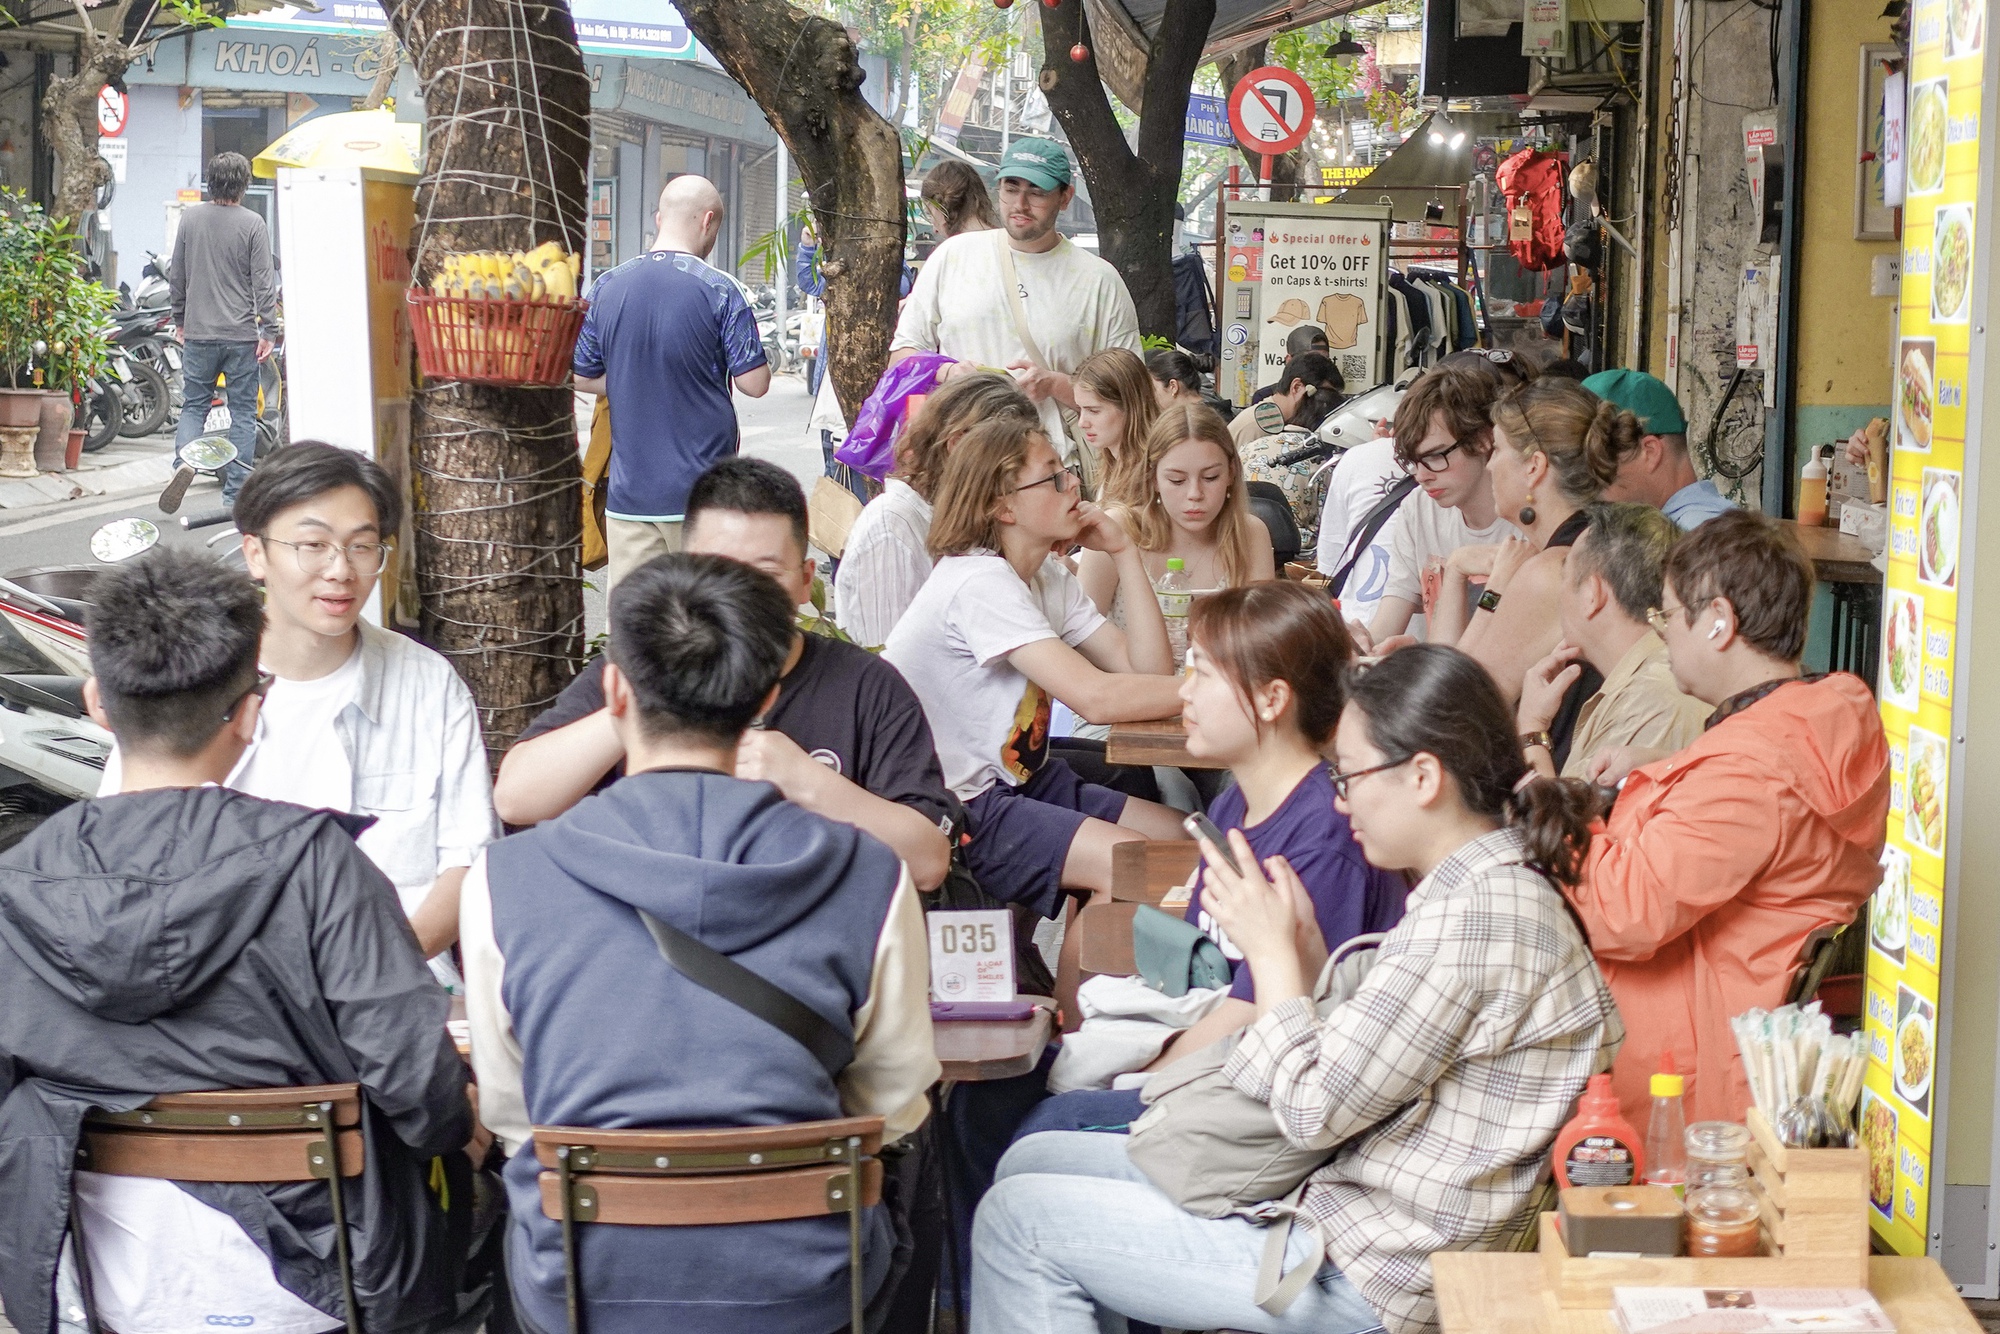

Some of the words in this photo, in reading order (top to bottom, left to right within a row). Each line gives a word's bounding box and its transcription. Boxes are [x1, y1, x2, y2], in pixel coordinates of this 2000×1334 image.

[215, 37, 321, 77] KHOÁ
[1321, 168, 1344, 179] THE
[1283, 233, 1324, 245] Special
[1329, 234, 1357, 245] Offer
[1270, 254, 1296, 270] Get
[1301, 254, 1336, 271] 10%
[1342, 255, 1370, 271] OFF
[1270, 276, 1283, 286] on
[1286, 275, 1310, 288] Caps
[1313, 275, 1321, 286] &
[1325, 276, 1368, 288] t-shirts!
[941, 923, 996, 953] 035
